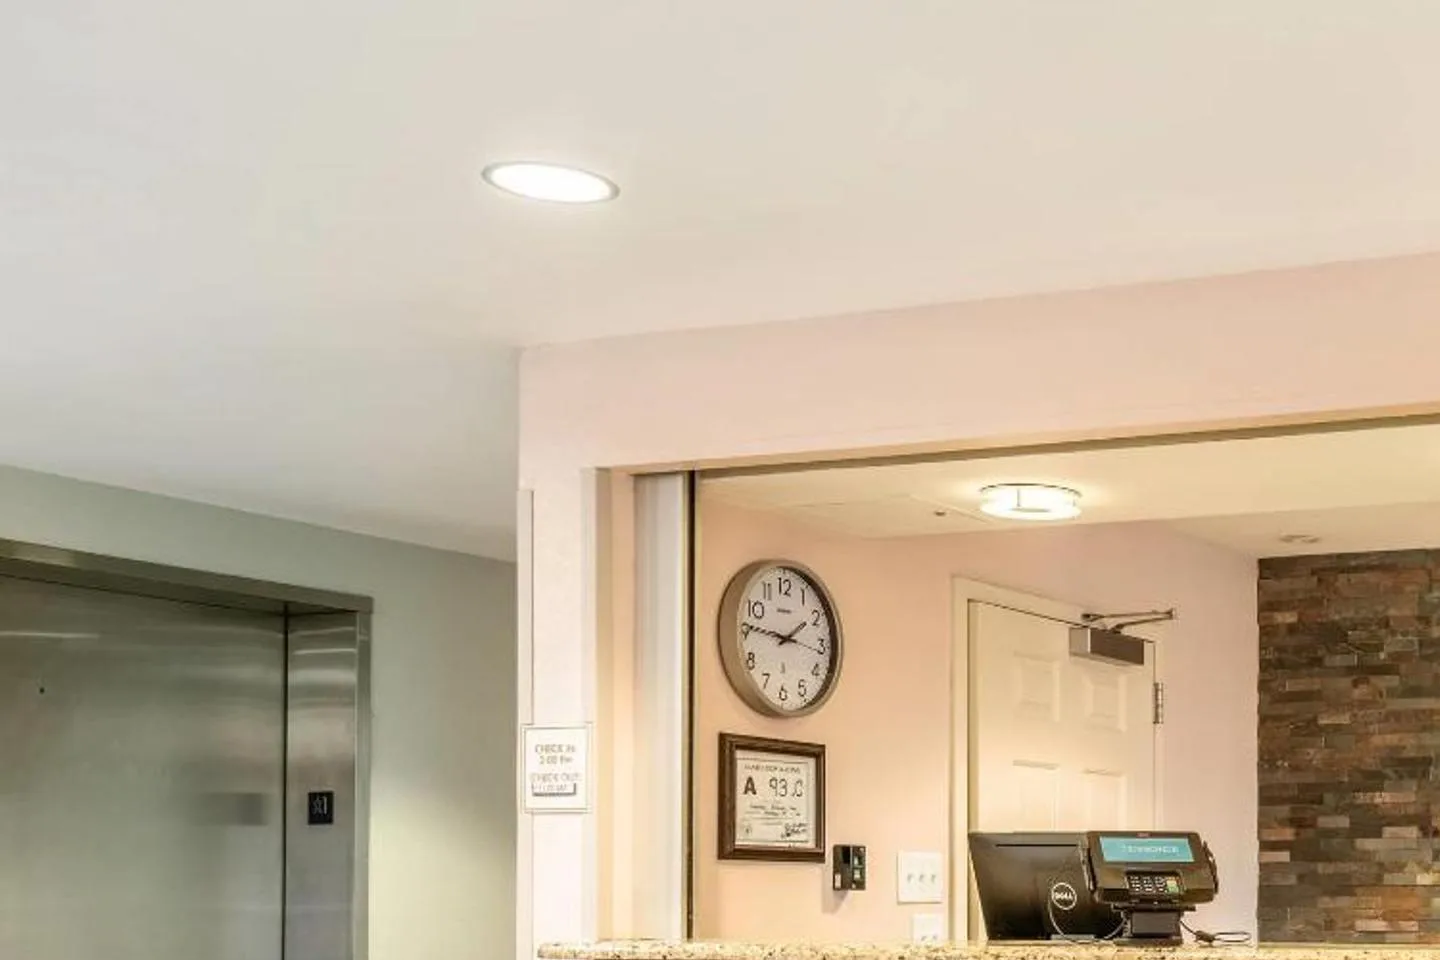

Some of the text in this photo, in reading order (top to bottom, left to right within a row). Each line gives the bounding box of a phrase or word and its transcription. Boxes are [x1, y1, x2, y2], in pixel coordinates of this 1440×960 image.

[762, 581, 772, 601] 11
[776, 577, 792, 597] 12
[800, 587, 806, 606] 1
[747, 599, 765, 620] 10
[811, 609, 821, 626] 2
[741, 622, 750, 640] 9
[816, 638, 826, 655] 3
[746, 652, 755, 670] 8
[811, 663, 820, 677] 4
[761, 672, 771, 689] 7
[798, 679, 807, 697] 5
[778, 685, 788, 701] 6
[743, 776, 757, 795] A
